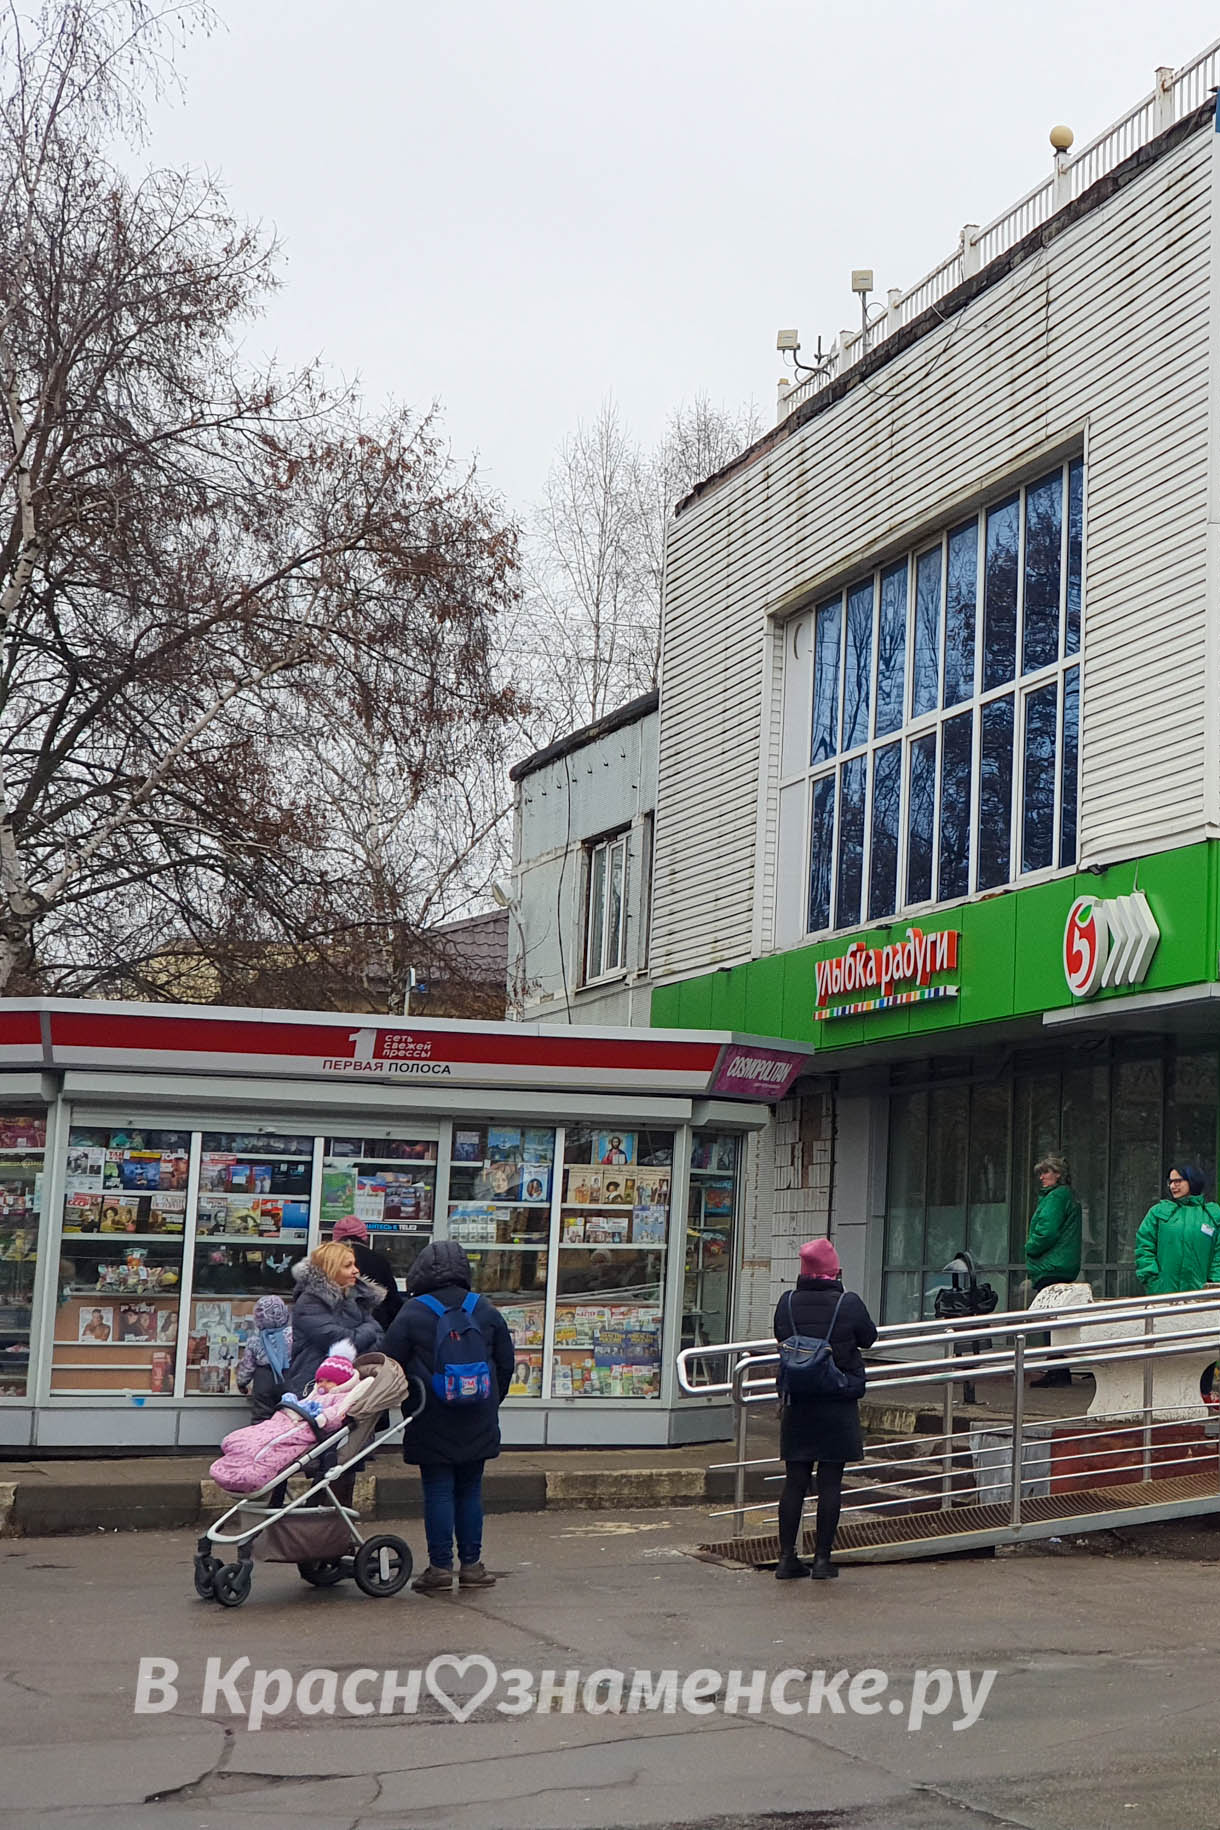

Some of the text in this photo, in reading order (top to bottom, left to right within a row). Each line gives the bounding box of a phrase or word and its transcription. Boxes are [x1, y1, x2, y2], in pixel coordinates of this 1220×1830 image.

[881, 928, 957, 997] радуги
[348, 1028, 378, 1059] 1
[385, 1034, 413, 1042] сеть
[384, 1041, 432, 1050] свежей
[382, 1049, 431, 1058] прессы
[323, 1060, 451, 1074] ПЕРВАЯ ПОЛОСА
[727, 1056, 793, 1083] COSMOPOLITAN
